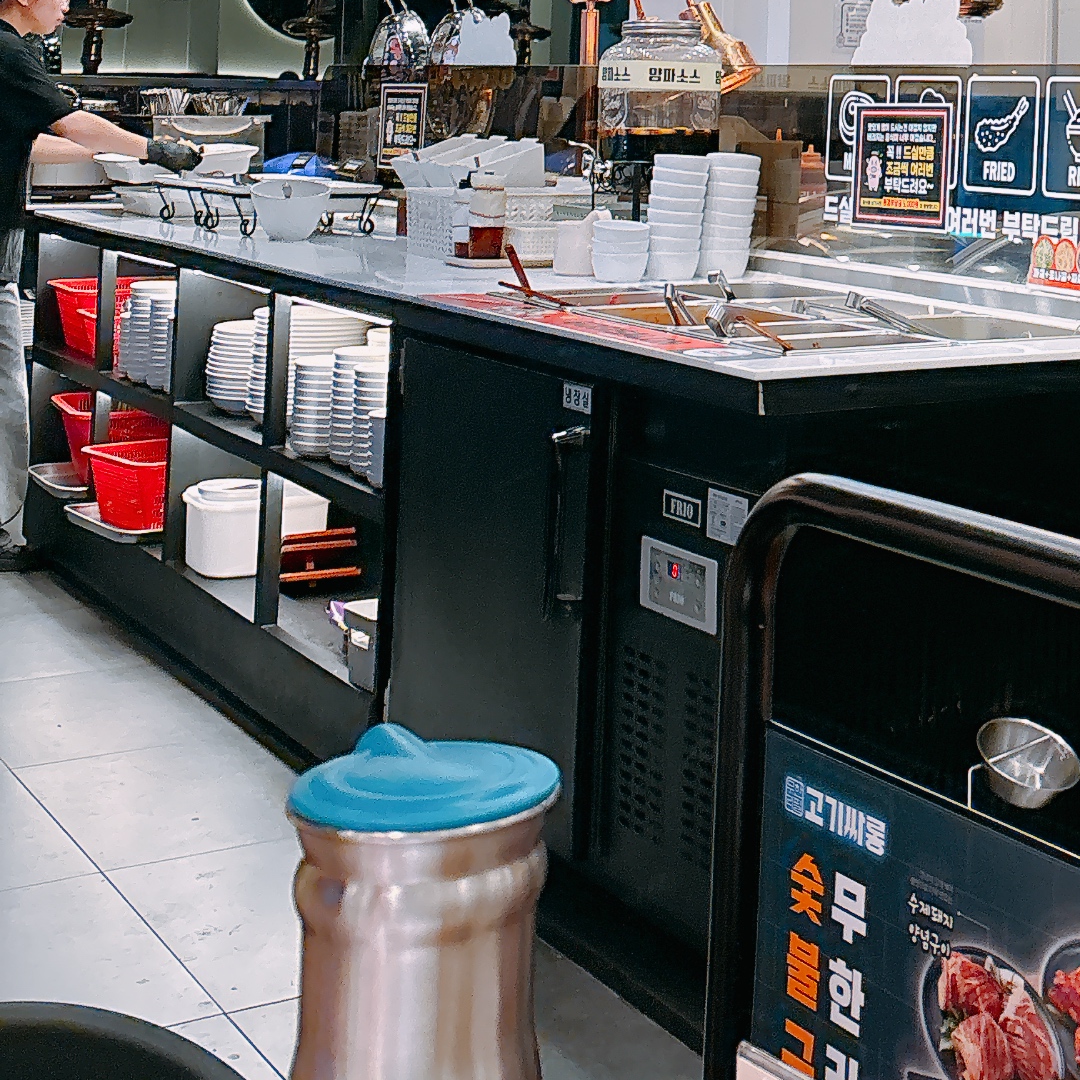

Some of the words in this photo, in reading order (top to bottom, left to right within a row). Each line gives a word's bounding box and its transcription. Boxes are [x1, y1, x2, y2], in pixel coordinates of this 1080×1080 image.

[903, 145, 935, 161] 드실만큼
[910, 162, 935, 178] 여러번
[982, 159, 1016, 184] FRIED
[947, 206, 997, 239] 여러번
[565, 387, 590, 408] 냉장실
[670, 497, 694, 520] FRIO
[804, 786, 886, 857] 고기싸롱
[908, 893, 954, 929] 수제돼지
[908, 923, 951, 957] 양념구이
